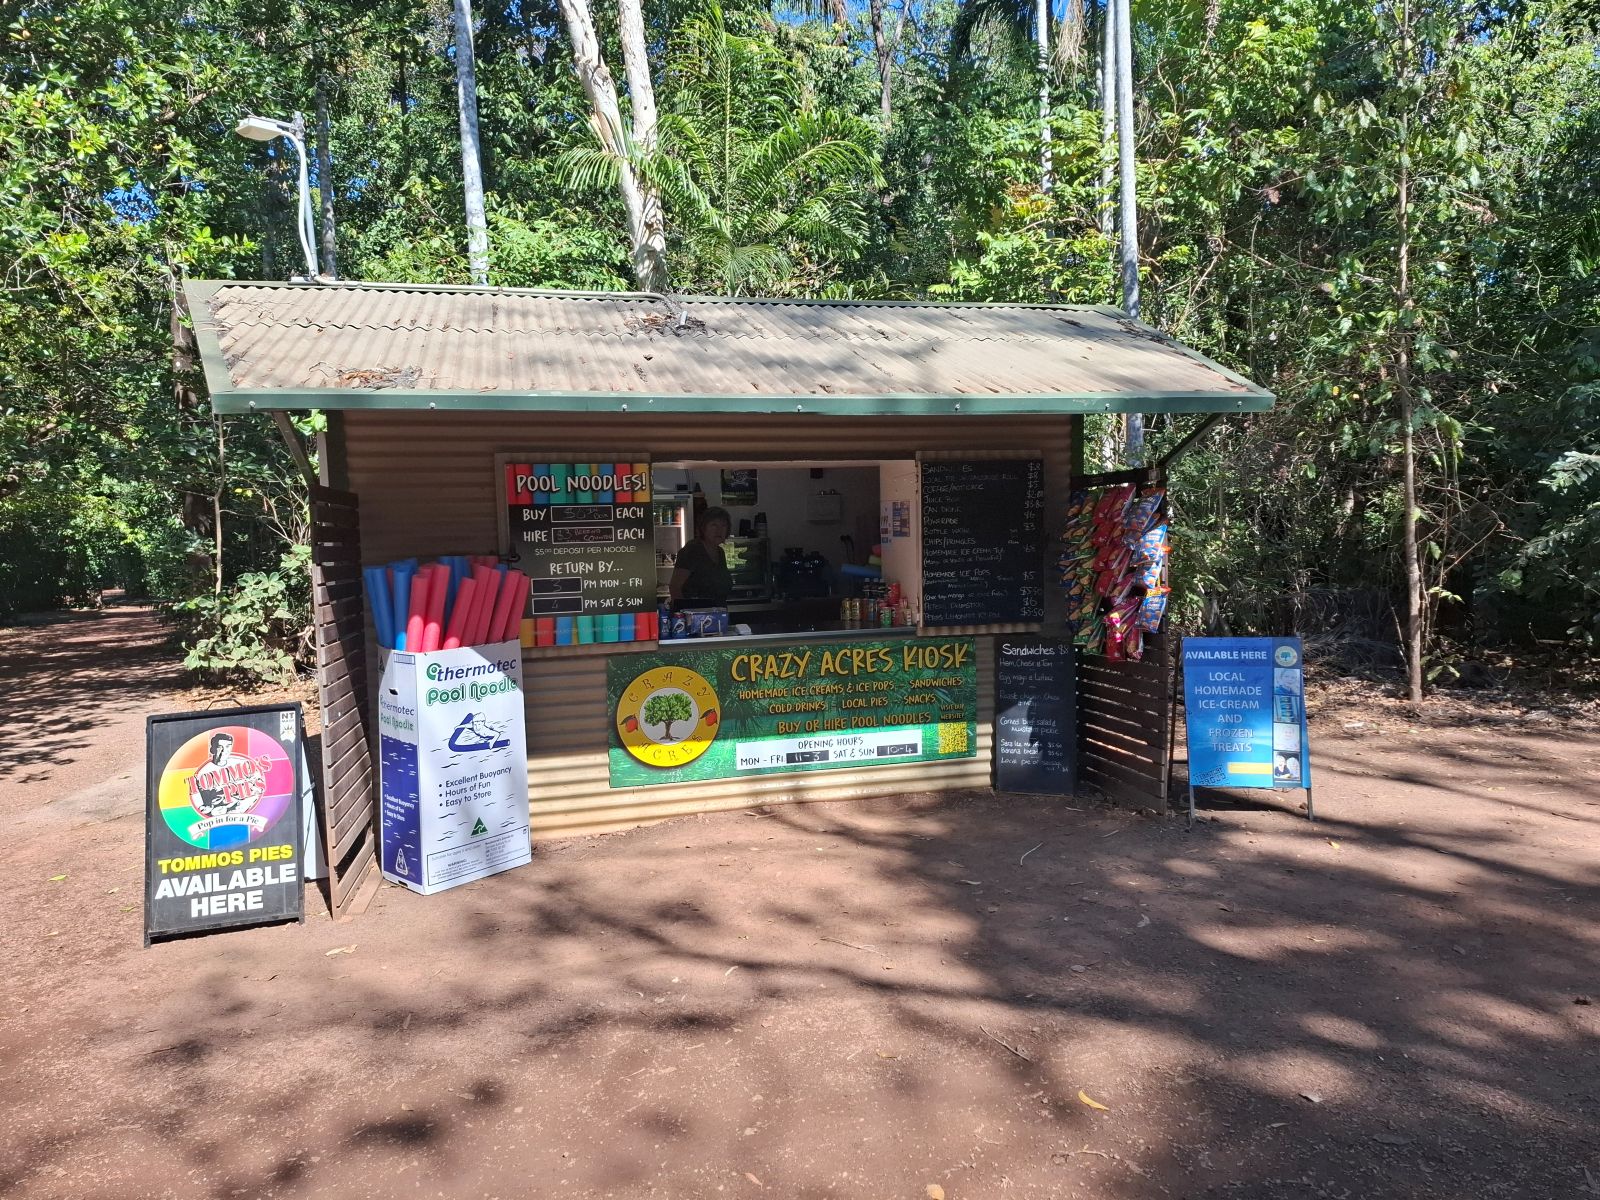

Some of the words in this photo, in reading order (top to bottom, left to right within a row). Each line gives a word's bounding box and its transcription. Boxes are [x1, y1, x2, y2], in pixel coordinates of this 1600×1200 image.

[516, 475, 560, 493] POOL
[567, 474, 646, 492] NOODLES!
[523, 509, 546, 520] BUY
[616, 507, 644, 518] EACH
[523, 530, 548, 542] HIRE
[617, 528, 645, 540] EACH
[550, 562, 593, 575] RETURN
[598, 561, 623, 573] BY...
[974, 568, 991, 576] POPS
[1023, 571, 1036, 580] $5
[584, 579, 596, 588] PM
[600, 579, 619, 588] MON
[629, 578, 642, 587] FRI
[585, 599, 598, 608] PM
[601, 598, 614, 608] SAT
[617, 598, 623, 606] &
[626, 598, 643, 606] SUN
[1002, 643, 1055, 656] Sandwiches
[1185, 651, 1239, 659] AVAILABLE
[1241, 651, 1267, 659] HERE
[731, 651, 811, 682] CRAZY
[820, 648, 894, 676] ACRES
[902, 643, 968, 671] KIOSK
[438, 659, 516, 681] thermotec
[1209, 672, 1245, 681] LOCAL
[629, 672, 710, 702] CRAZY
[739, 687, 788, 700] HOMEMADE
[791, 687, 805, 697] ICE
[809, 683, 844, 695] CREAMS
[846, 683, 853, 694] &
[856, 683, 870, 692] ICE
[873, 681, 894, 692] POPS
[909, 677, 963, 688] SANDWICHES
[1195, 686, 1262, 695] HOMEMADE
[769, 704, 792, 714] COLD
[795, 702, 826, 712] DRINKS
[842, 698, 866, 708] LOCAL
[870, 697, 888, 707] PIES
[903, 693, 935, 705] SNACKS
[1199, 700, 1259, 709] ICE-CREAM
[778, 721, 802, 734] BUY
[805, 720, 819, 731] OR
[824, 718, 848, 729] HIRE
[851, 715, 879, 728] POOL
[883, 712, 931, 725] NOODLES
[1000, 717, 1019, 725] Corned
[1217, 714, 1243, 723] AND
[1209, 729, 1254, 738] FROZEN
[639, 735, 702, 761] ACRES
[798, 740, 834, 749] OPENING
[837, 737, 864, 745] HOURS
[1212, 742, 1252, 752] TREATS
[741, 758, 759, 766] MON
[833, 749, 847, 758] SAT
[849, 750, 855, 758] &
[859, 748, 874, 757] SUN
[446, 774, 477, 788] Excellent
[480, 767, 512, 779] Buoyancy
[446, 788, 467, 797] Hours
[470, 782, 477, 791] of
[479, 781, 491, 789] Fun
[446, 798, 462, 807] Easy
[474, 790, 491, 800] Store
[197, 820, 215, 830] Pop
[215, 816, 224, 825] in
[226, 815, 238, 823] for
[246, 815, 259, 824] Pie
[158, 850, 244, 875] TOMMOS
[249, 844, 293, 863] PIES
[154, 863, 297, 900] AVAILABLE
[190, 890, 264, 919] HERE
